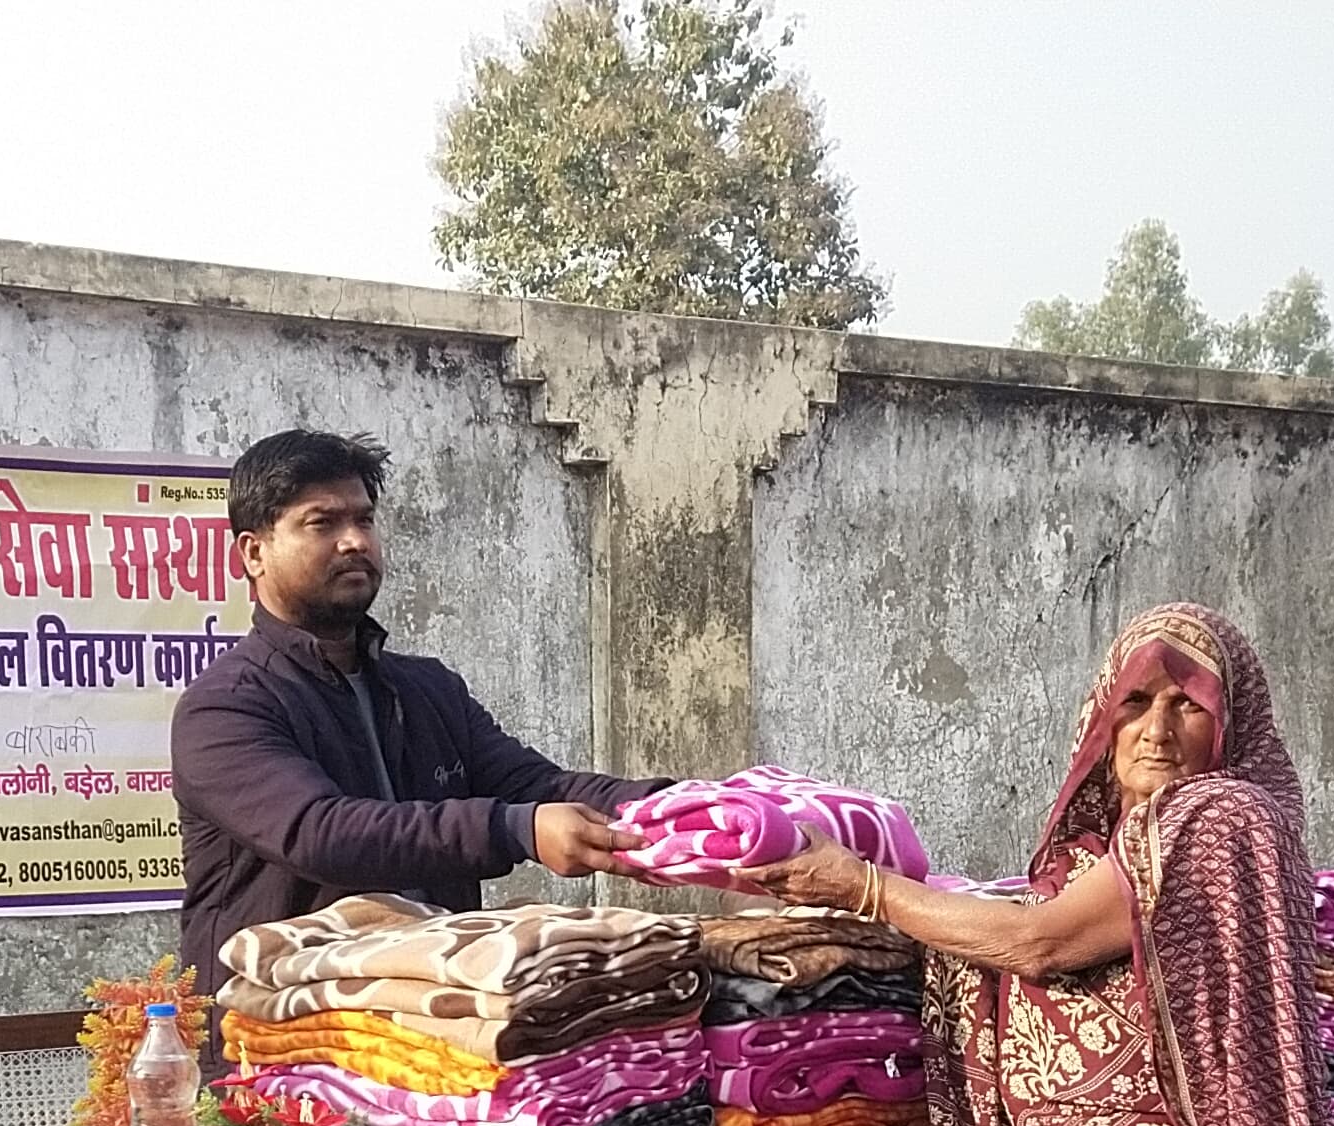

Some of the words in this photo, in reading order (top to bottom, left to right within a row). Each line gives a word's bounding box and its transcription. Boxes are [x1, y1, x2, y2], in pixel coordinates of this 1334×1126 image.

[161, 485, 204, 502] Reg.No.:
[207, 487, 228, 500] 535
[36, 614, 146, 688] वितरण
[19, 859, 133, 884] 8005160005,
[138, 857, 185, 878] 9336
